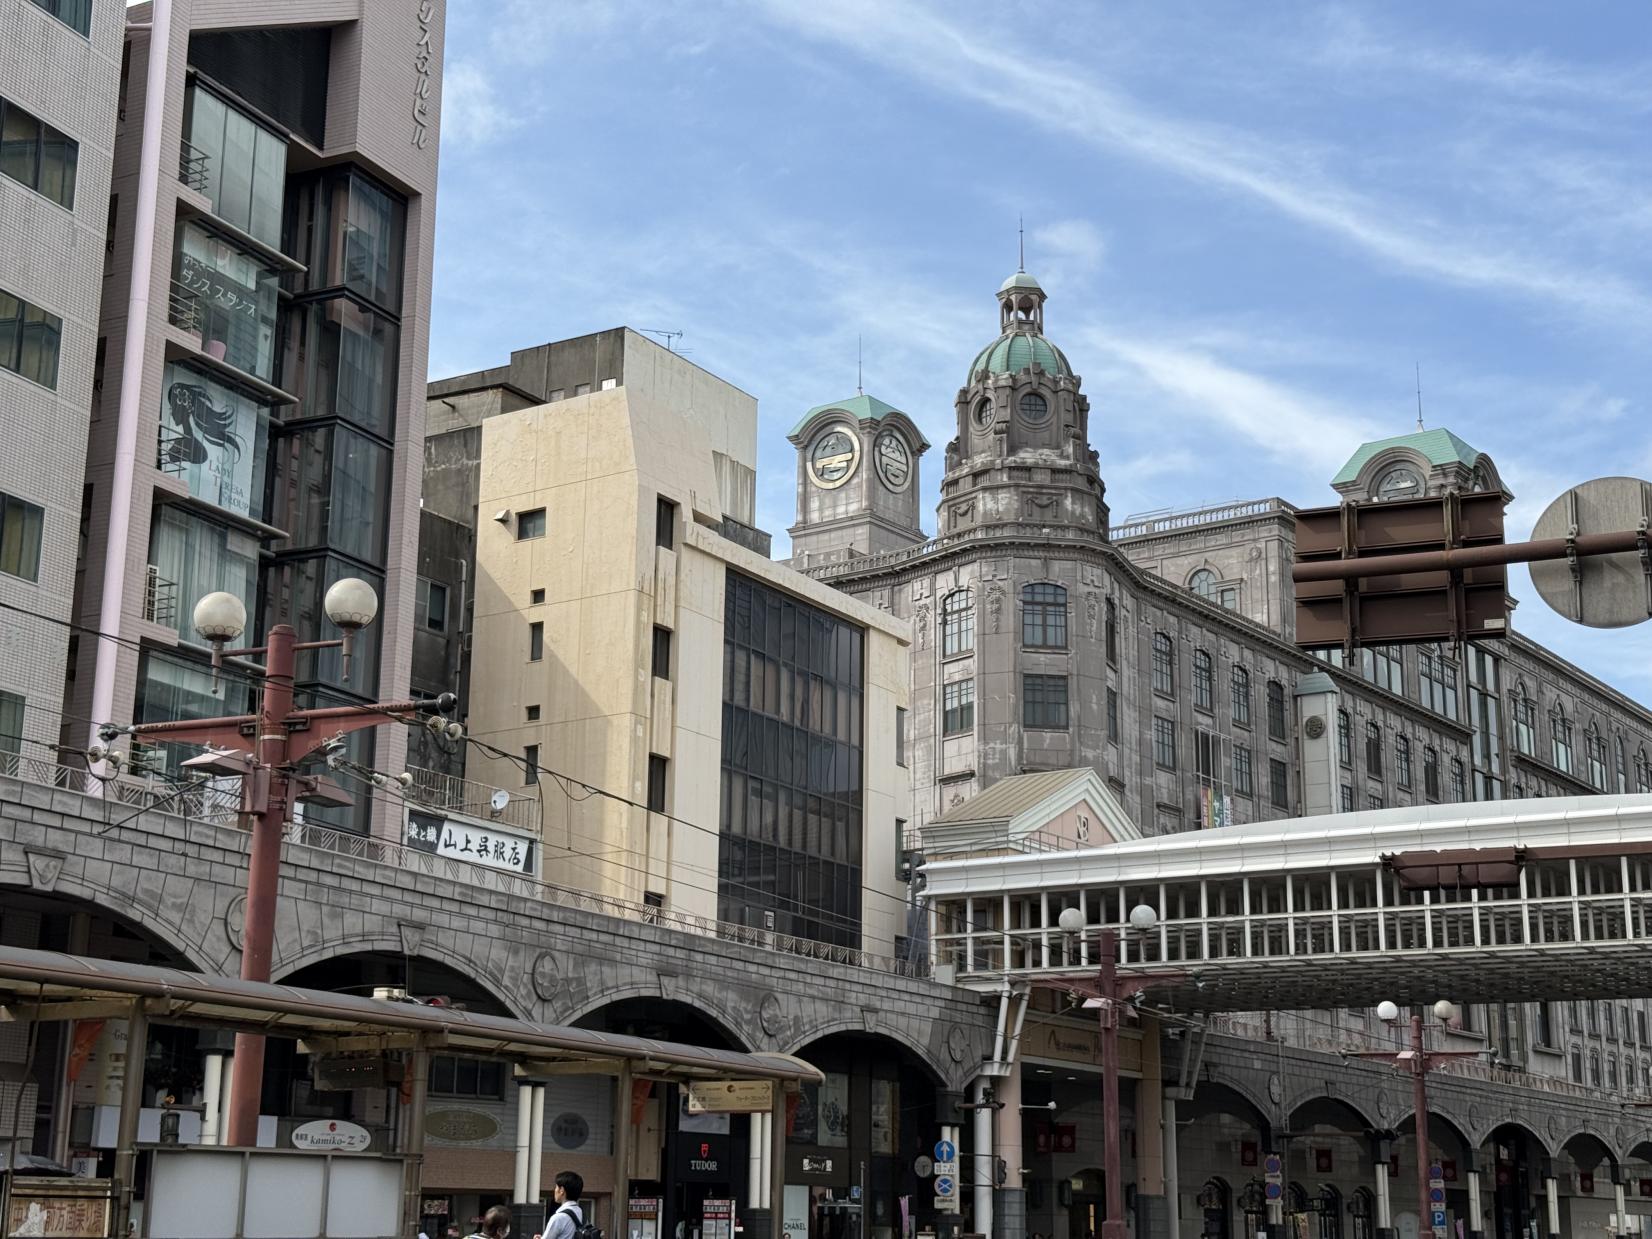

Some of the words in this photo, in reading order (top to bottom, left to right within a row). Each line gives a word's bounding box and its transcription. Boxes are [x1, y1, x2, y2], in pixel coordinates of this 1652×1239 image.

[208, 459, 232, 478] LADY
[212, 474, 244, 498] TRESA
[443, 828, 522, 866] 山上呉服店
[690, 1160, 718, 1171] TUDOR
[13, 1201, 103, 1232] 中前方面乗り場
[1435, 1212, 1444, 1225] P
[783, 1222, 807, 1231] CHANEL
